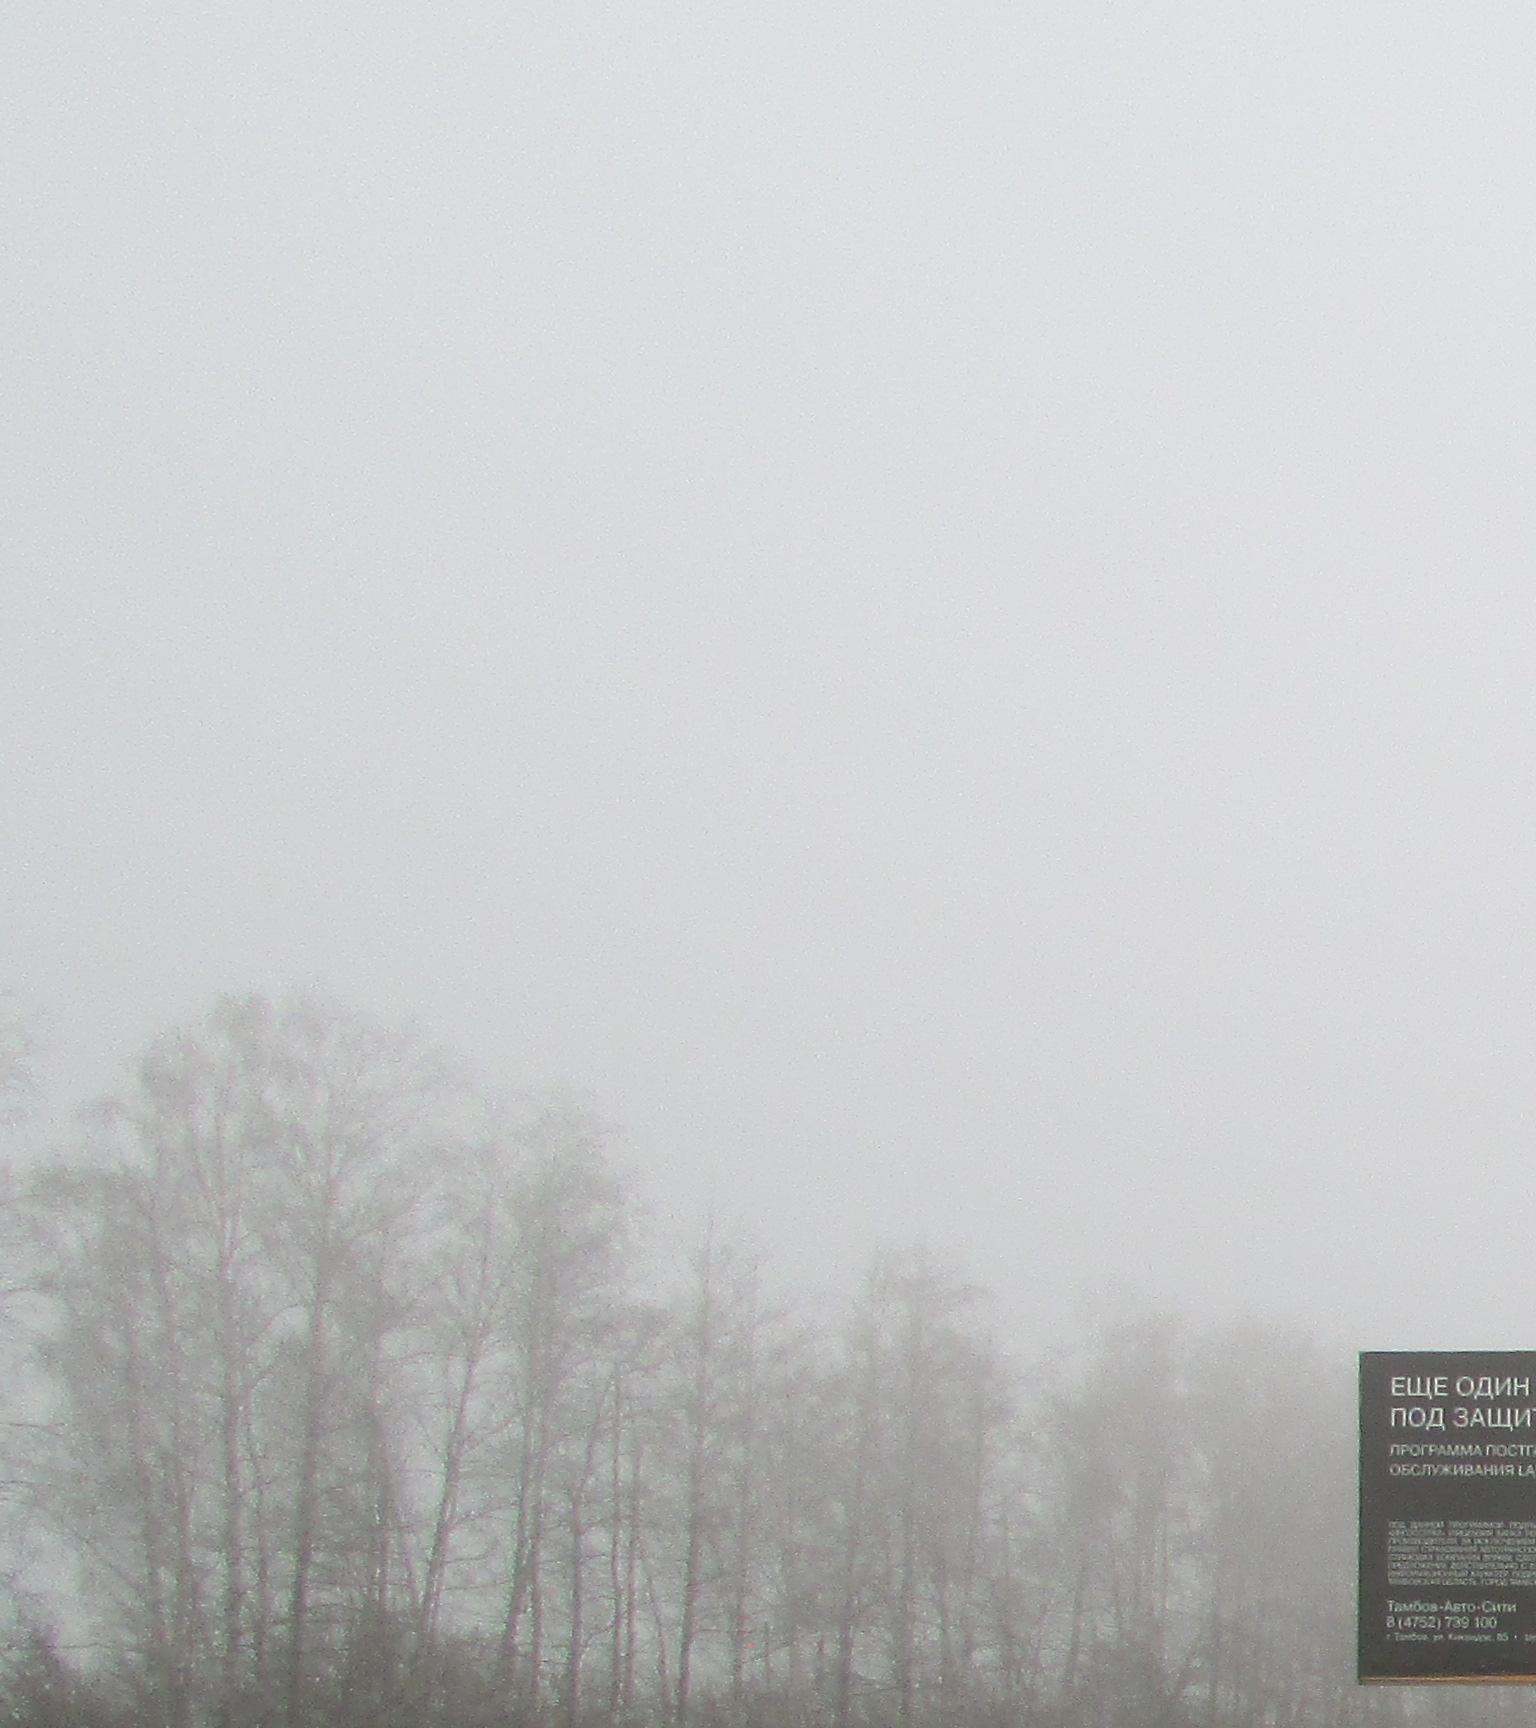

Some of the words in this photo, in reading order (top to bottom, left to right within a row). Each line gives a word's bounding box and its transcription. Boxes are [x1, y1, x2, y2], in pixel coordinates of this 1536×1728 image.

[1391, 1376, 1448, 1400] ЕЩЕ
[1456, 1376, 1529, 1400] ОДИН
[1391, 1407, 1446, 1431] ПОД
[1389, 1444, 1483, 1458] ПРОГРАММА
[1389, 1463, 1515, 1477] ОБСЛУЖИВАНИЯ
[1387, 1600, 1517, 1613] Тамбов-Авто-Сити
[1386, 1616, 1396, 1629] 8
[1398, 1616, 1442, 1631] (4752)
[1445, 1616, 1470, 1629] 739
[1474, 1616, 1498, 1629] 100
